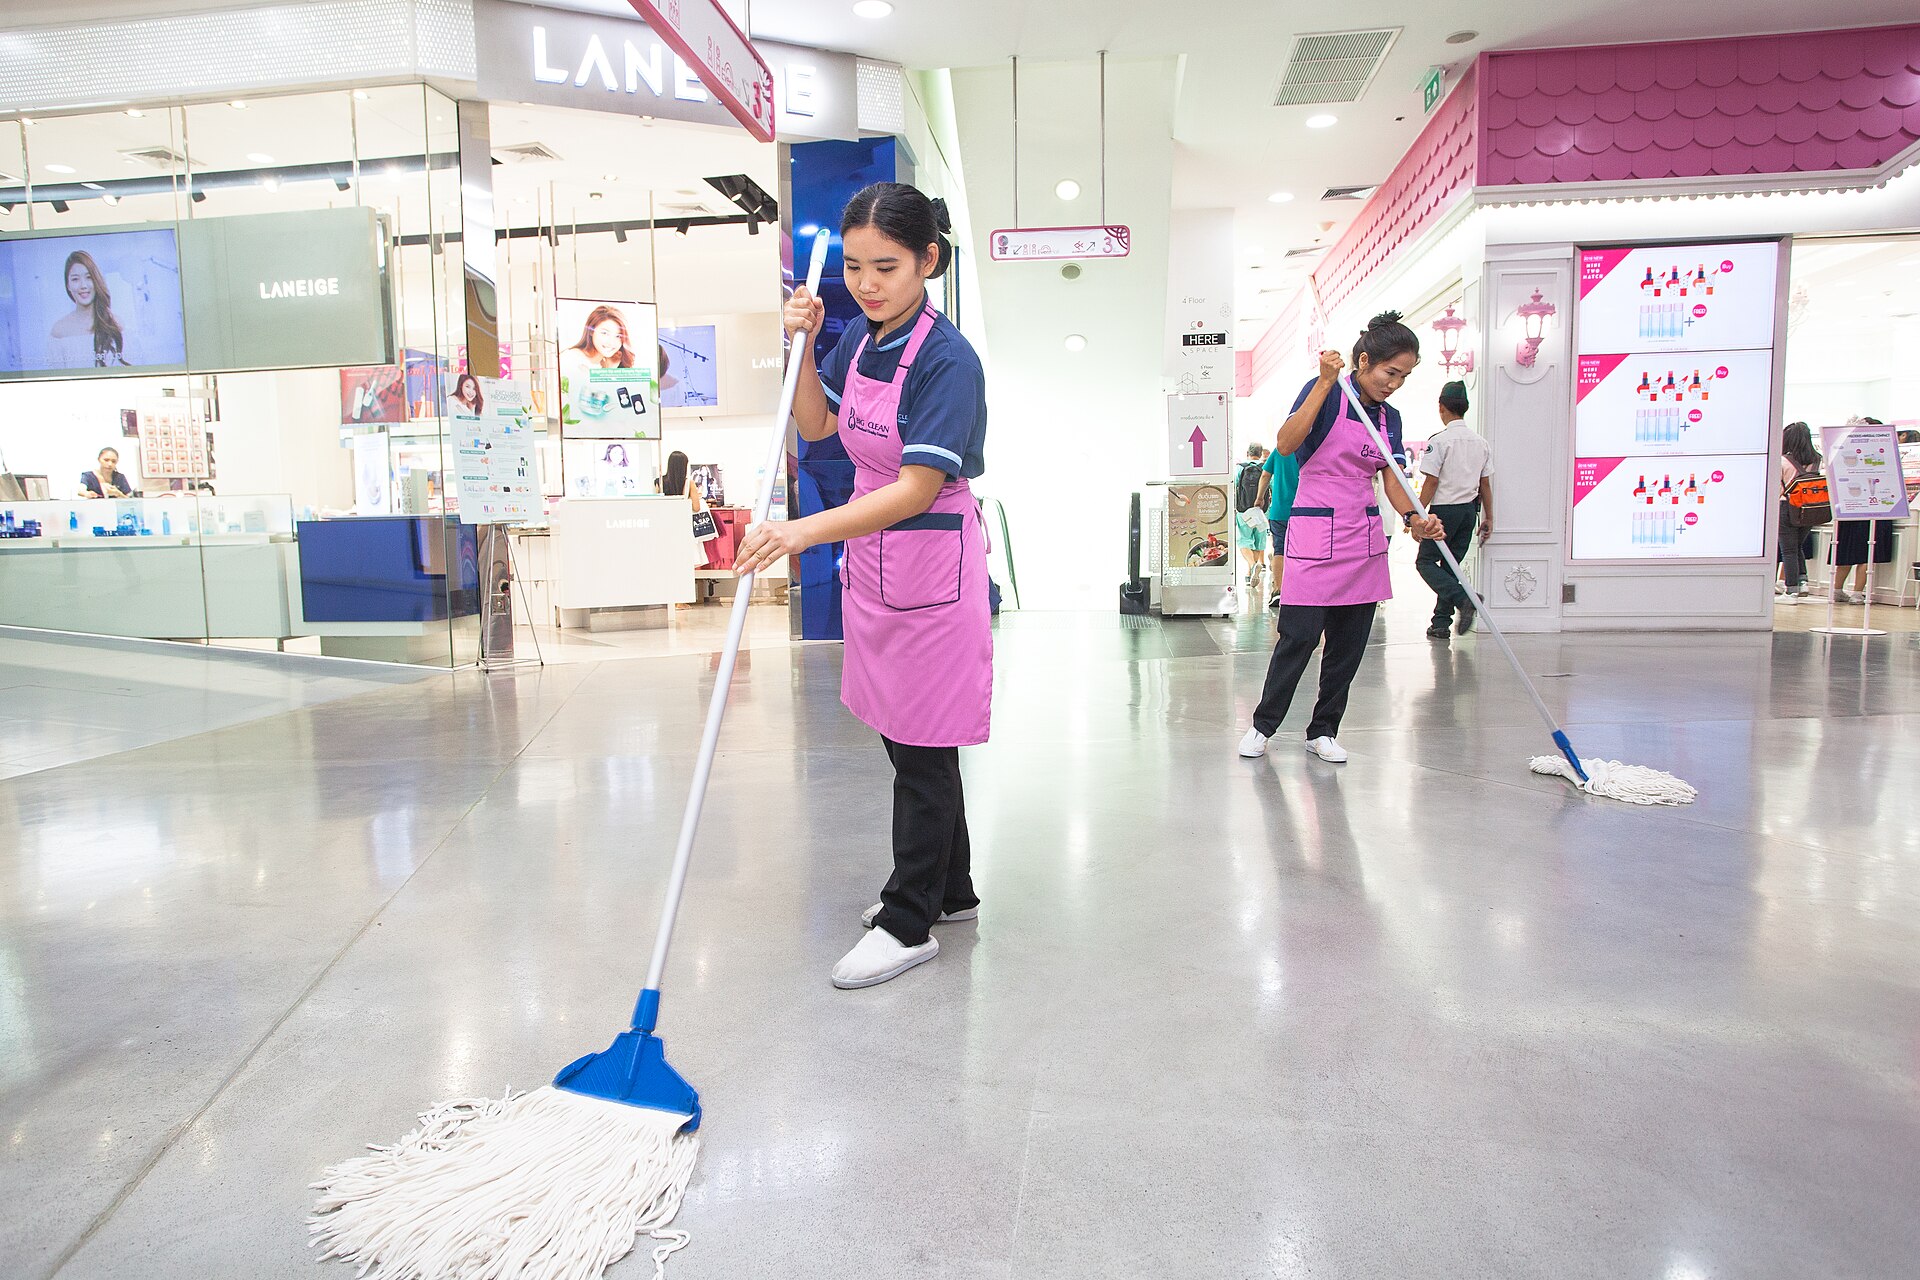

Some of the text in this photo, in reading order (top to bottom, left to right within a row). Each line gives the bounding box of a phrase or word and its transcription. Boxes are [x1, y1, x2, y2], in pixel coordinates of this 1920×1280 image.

[532, 25, 817, 118] LANEE
[752, 81, 763, 119] 3
[1102, 236, 1113, 253] 3
[260, 277, 340, 299] LANEIGE
[1189, 334, 1219, 345] HERE
[1189, 346, 1219, 354] SPACE
[856, 417, 865, 426] BIG
[867, 421, 890, 433] CLEAN
[606, 518, 650, 528] LANEIGE
